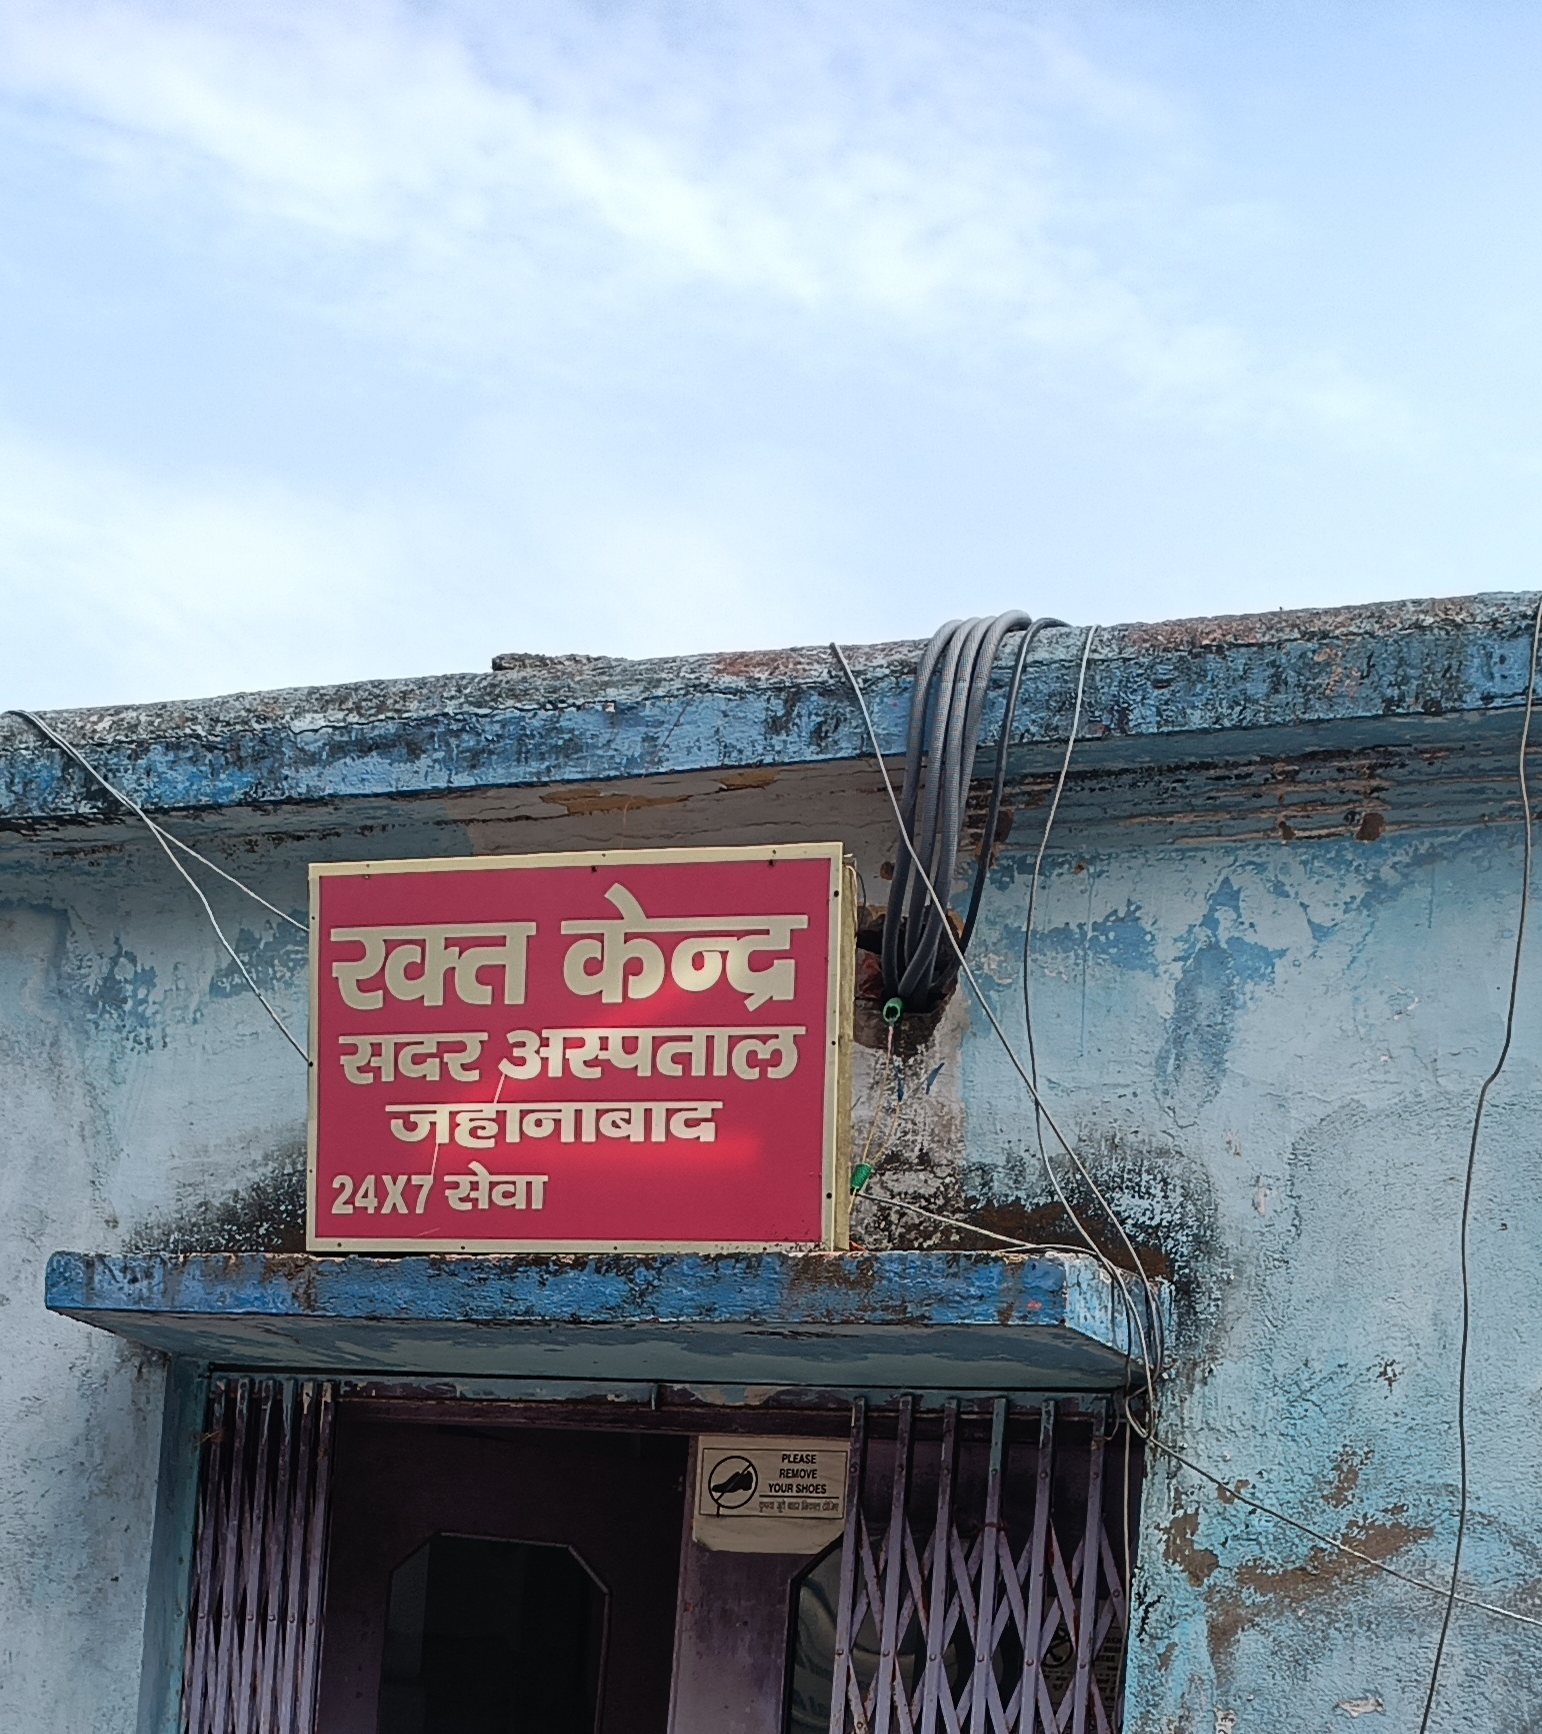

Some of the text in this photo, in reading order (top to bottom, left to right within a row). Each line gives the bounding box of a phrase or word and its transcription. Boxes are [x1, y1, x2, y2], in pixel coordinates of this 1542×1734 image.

[330, 882, 809, 1011] रक्त केन्द्र
[338, 1025, 806, 1084] सदर अस्पताल
[385, 1101, 723, 1148] जहानाबाद
[331, 1161, 548, 1214] 24X7 सेवा
[779, 1468, 817, 1479] REMOVE
[781, 1453, 817, 1464] PLEASE
[768, 1483, 827, 1494] YOUR SHOES
